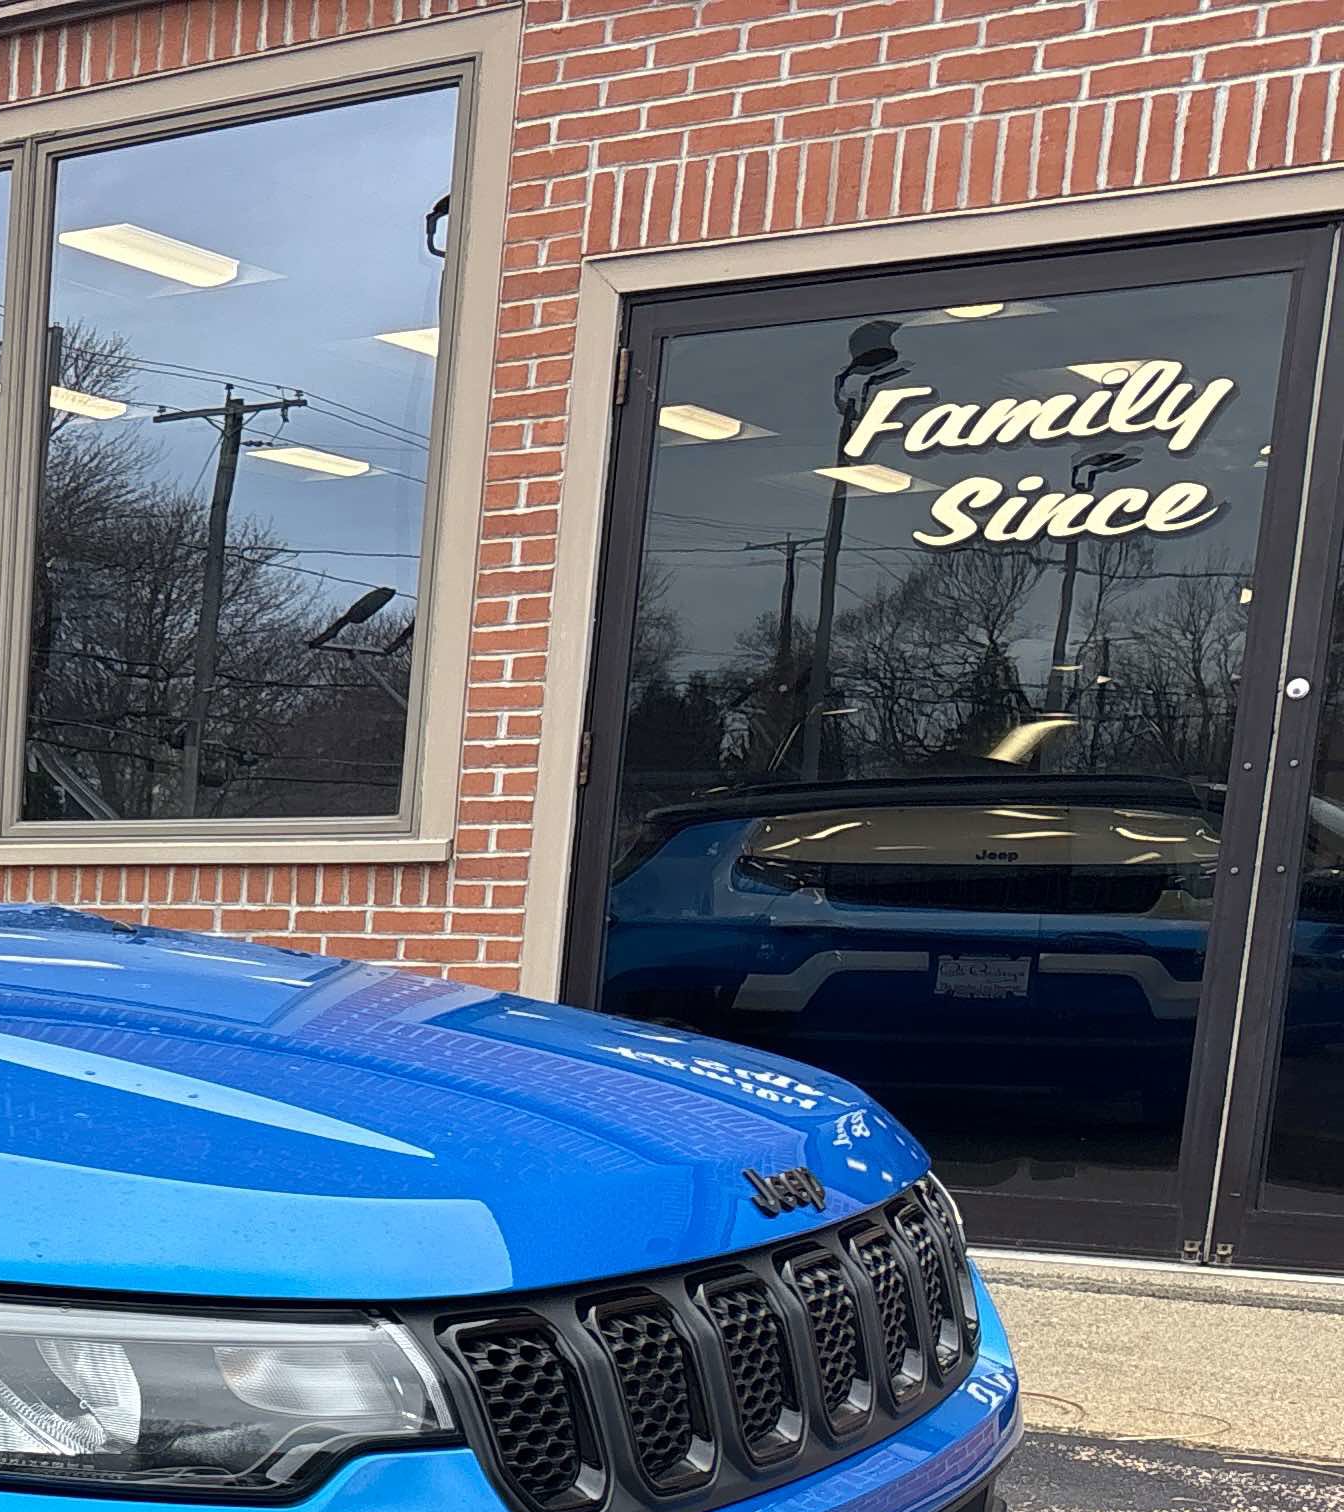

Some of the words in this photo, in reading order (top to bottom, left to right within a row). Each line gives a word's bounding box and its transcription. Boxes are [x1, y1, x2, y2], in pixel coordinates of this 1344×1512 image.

[843, 360, 1235, 458] Family
[912, 475, 1219, 547] Since
[976, 849, 1018, 862] Jeep
[742, 1167, 826, 1220] Jeep
